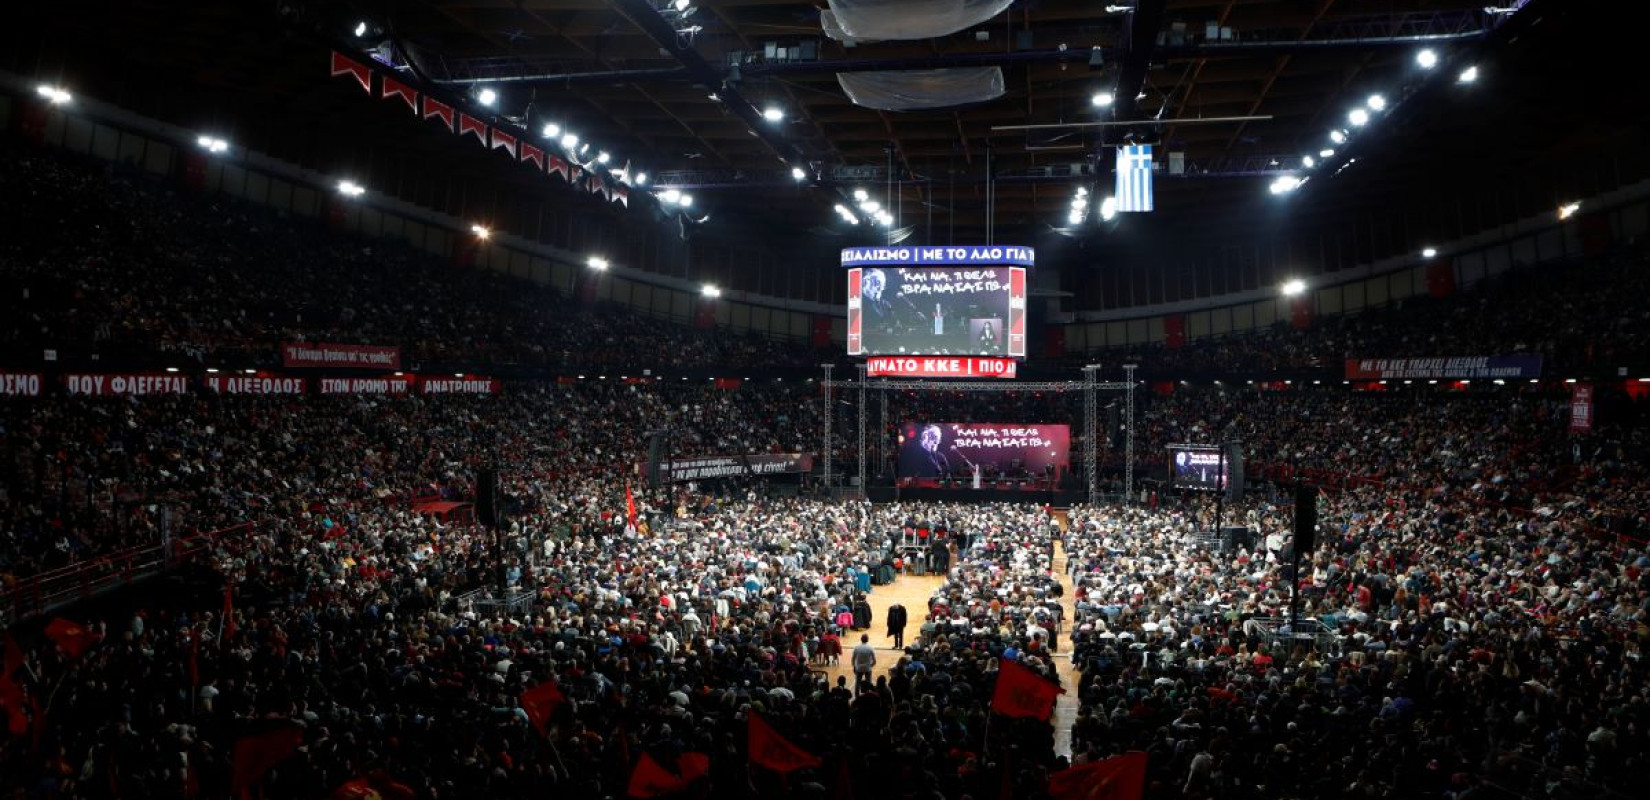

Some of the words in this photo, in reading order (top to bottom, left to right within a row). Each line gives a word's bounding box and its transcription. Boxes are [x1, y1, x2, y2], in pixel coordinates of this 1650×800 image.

[923, 249, 943, 260] ΜΕ
[946, 249, 967, 260] ΤΟ
[970, 249, 1002, 260] ΛΑΟ
[1006, 249, 1027, 260] ΓΙΑ
[923, 359, 960, 372] ΚΚΕ
[979, 359, 1005, 373] ΠΙΟ
[69, 375, 104, 396] ΠΟΥ
[111, 376, 187, 395] ΦΛΕΓΕΤΑΙ
[227, 378, 302, 393] ΔΙΕΞΟΔΟΣ
[321, 378, 350, 393] ΣΤΟΝ
[352, 379, 388, 393] ΔΡΟΜΟ
[424, 379, 492, 394] ΑΝΑΤΡΟΠΗΣ
